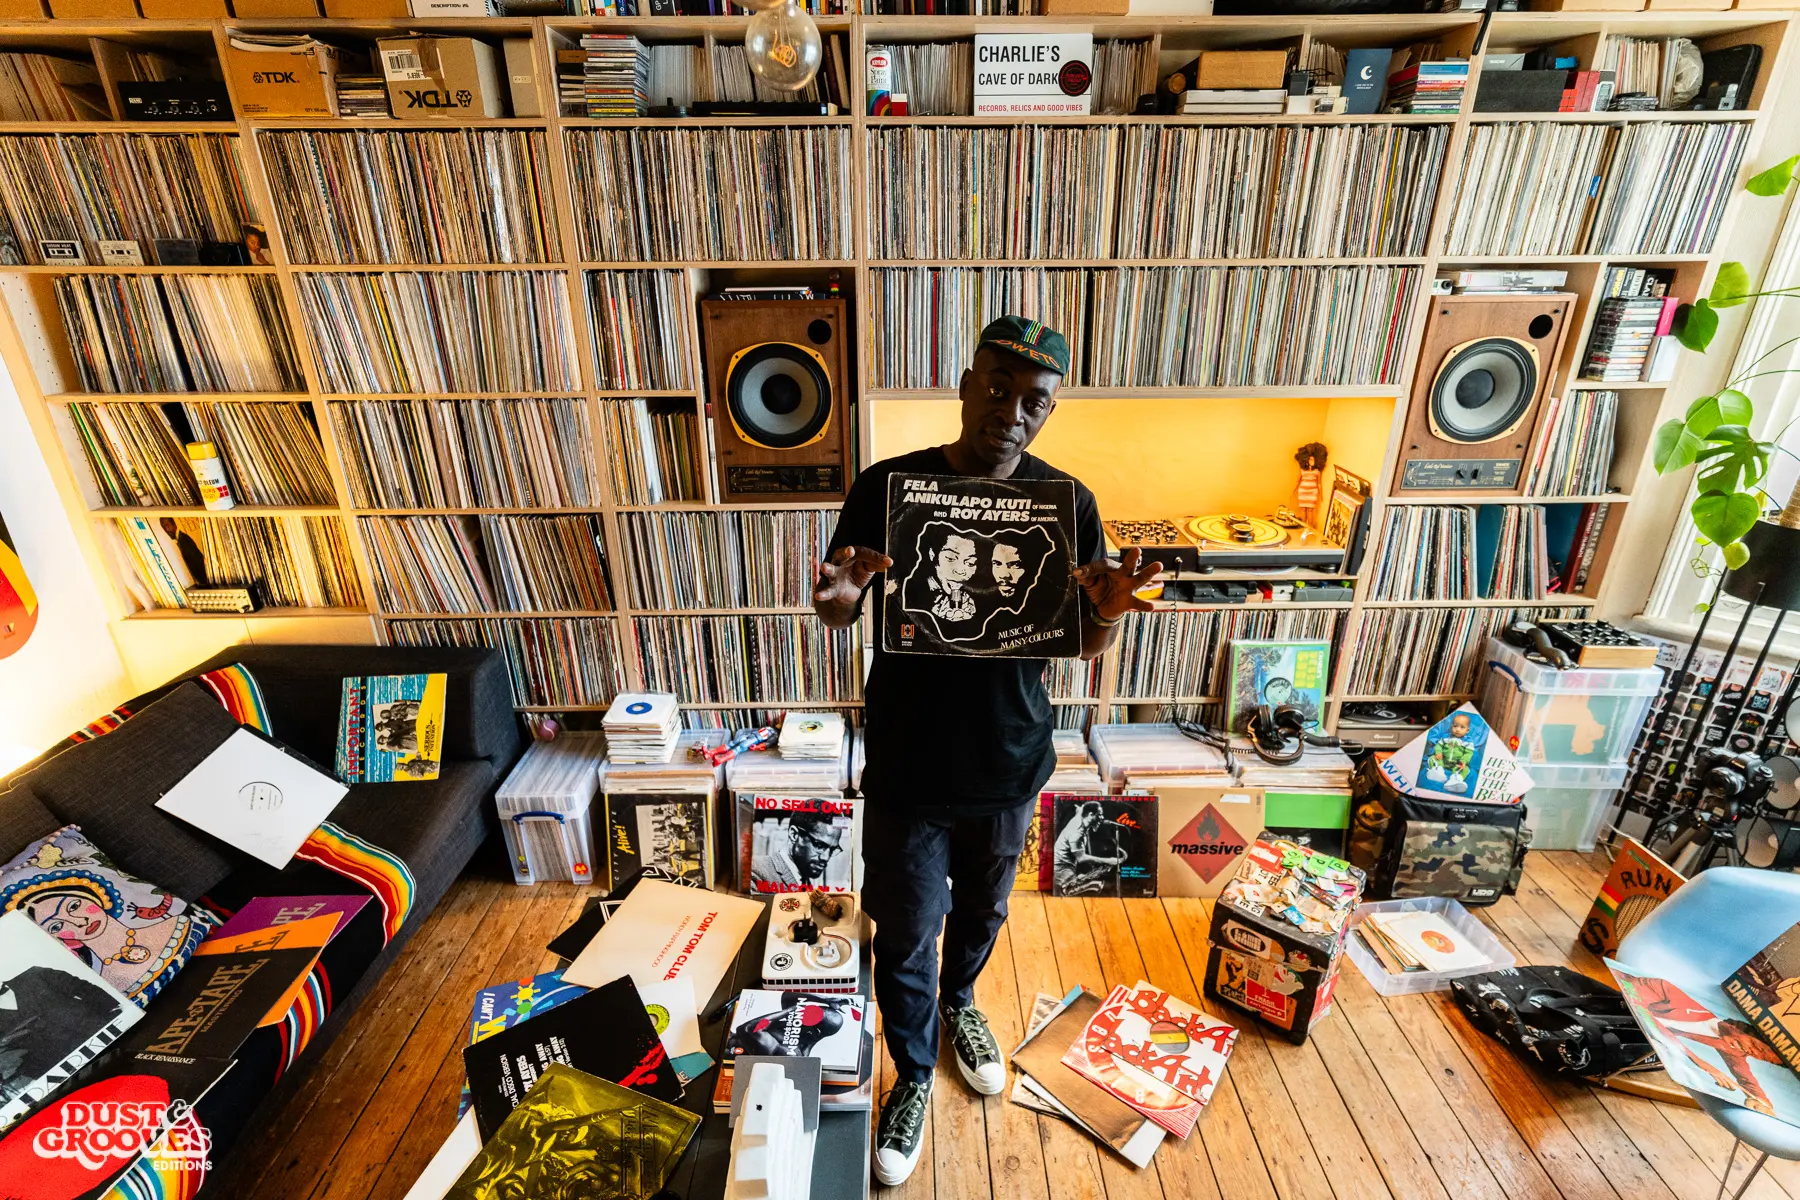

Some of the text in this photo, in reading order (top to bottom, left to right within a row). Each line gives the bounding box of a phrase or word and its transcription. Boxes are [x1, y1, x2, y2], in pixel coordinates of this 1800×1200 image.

[979, 45, 1060, 63] CHARLIE'S
[978, 73, 1006, 85] CAVE
[1010, 73, 1025, 85] OF
[1028, 73, 1059, 85] DARK
[978, 104, 1009, 112] RECORDS,
[1010, 104, 1032, 112] RELICS
[1032, 104, 1046, 112] AND
[1046, 104, 1065, 112] GOOD
[995, 339, 1061, 369] OWETO
[903, 479, 939, 492] FELA
[903, 492, 992, 509] ANIKULAPO
[995, 498, 1032, 510] KUTI
[933, 510, 948, 518] AND
[949, 507, 982, 520] ROY
[981, 510, 1030, 522] AYERS
[998, 624, 1035, 640] MUSIC OF
[1000, 628, 1064, 650] MANY COLOURS
[347, 688, 360, 776] IMPORTANT
[359, 685, 367, 775] RECORDS
[1482, 767, 1512, 780] GOT
[1486, 757, 1518, 772] HE'S
[1480, 777, 1510, 791] THE
[1474, 787, 1515, 803] BEAT
[755, 798, 853, 815] NO SELL OUT
[616, 825, 635, 855] Alive!
[1170, 841, 1244, 856] massive
[1621, 869, 1672, 893] RUN
[697, 911, 718, 932] TOM
[682, 932, 704, 954] TOM
[1727, 979, 1764, 1019] DAMA
[786, 997, 808, 1056] MANORISM
[535, 1043, 548, 1062] AWAY
[549, 1036, 562, 1055] AWAY
[500, 1053, 511, 1077] VERSION
[516, 1055, 532, 1080] AYERS
[505, 1076, 516, 1095] DISCO
